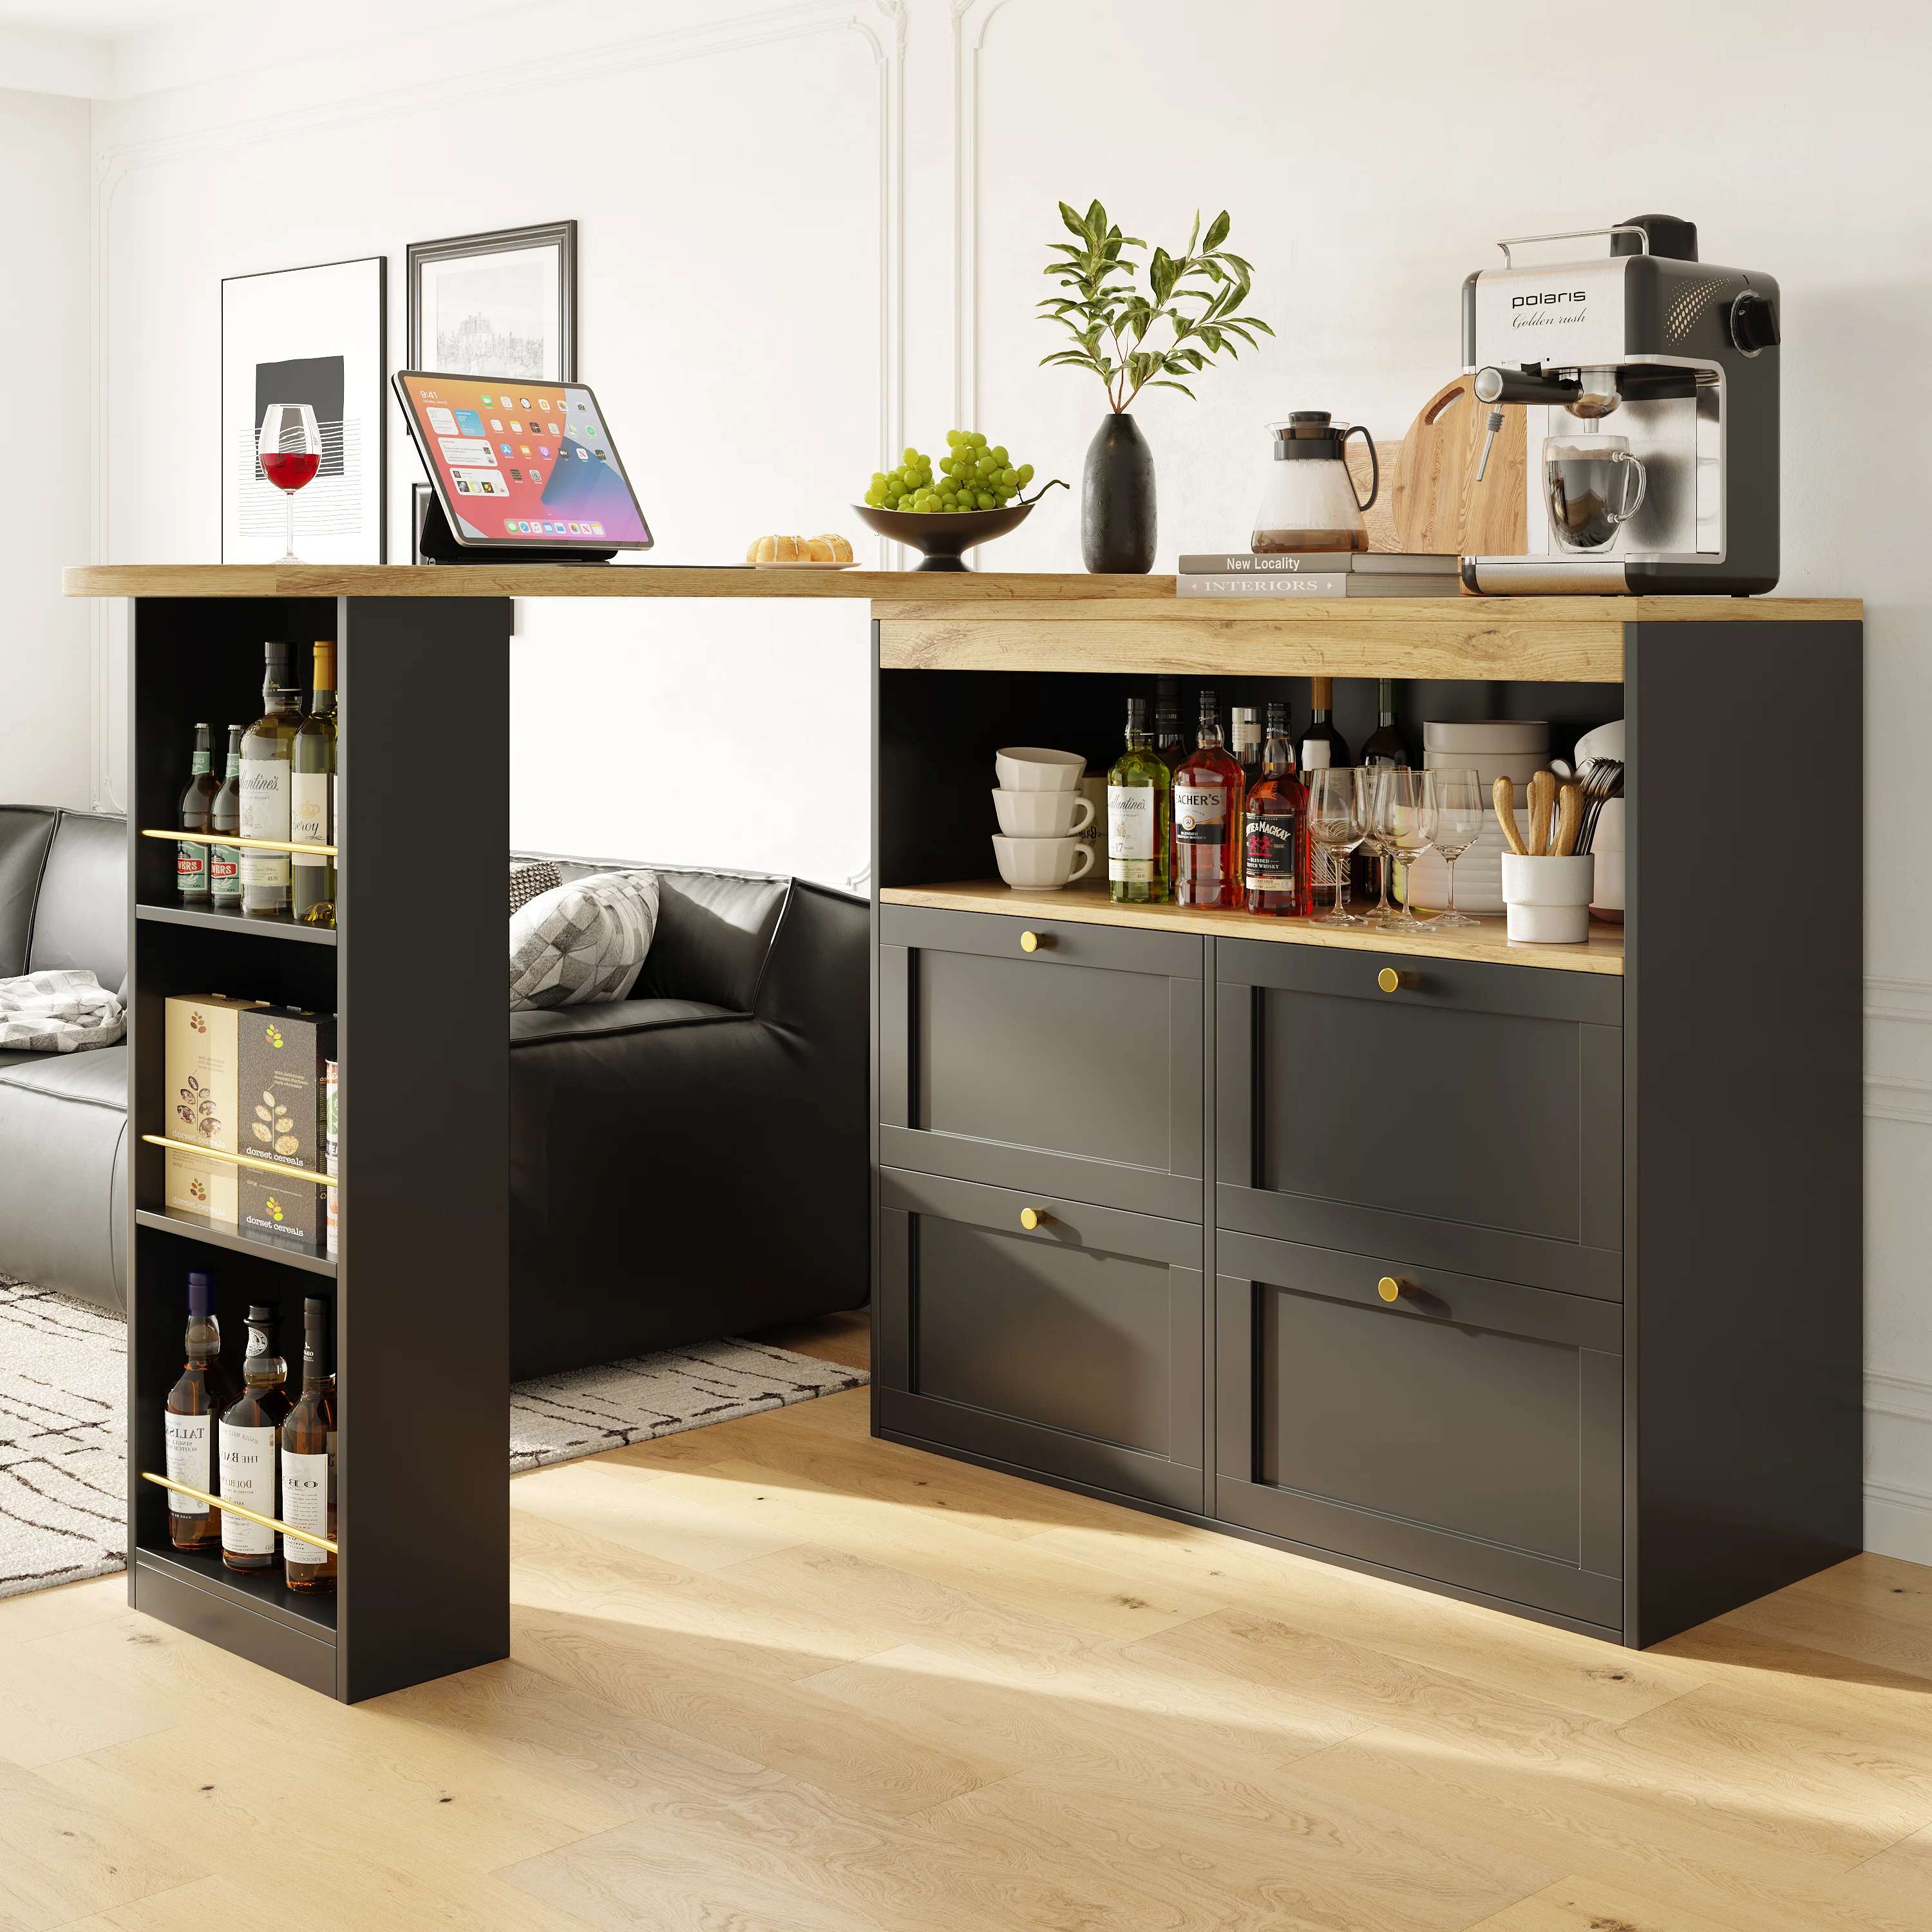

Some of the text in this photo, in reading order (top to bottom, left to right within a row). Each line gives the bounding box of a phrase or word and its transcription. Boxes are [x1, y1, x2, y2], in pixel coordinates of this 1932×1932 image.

[1512, 291, 1586, 309] polaris
[1512, 307, 1587, 330] Golden rush
[420, 390, 438, 399] 9:41
[1227, 557, 1300, 571] New Locality
[1204, 580, 1318, 591] INTERIORS
[1115, 842, 1123, 852] 17
[172, 1130, 226, 1148] dorset cereals
[246, 1146, 303, 1166] dorset cereals
[172, 1196, 226, 1216] dorset cereals
[246, 1215, 303, 1236] dorset cereals
